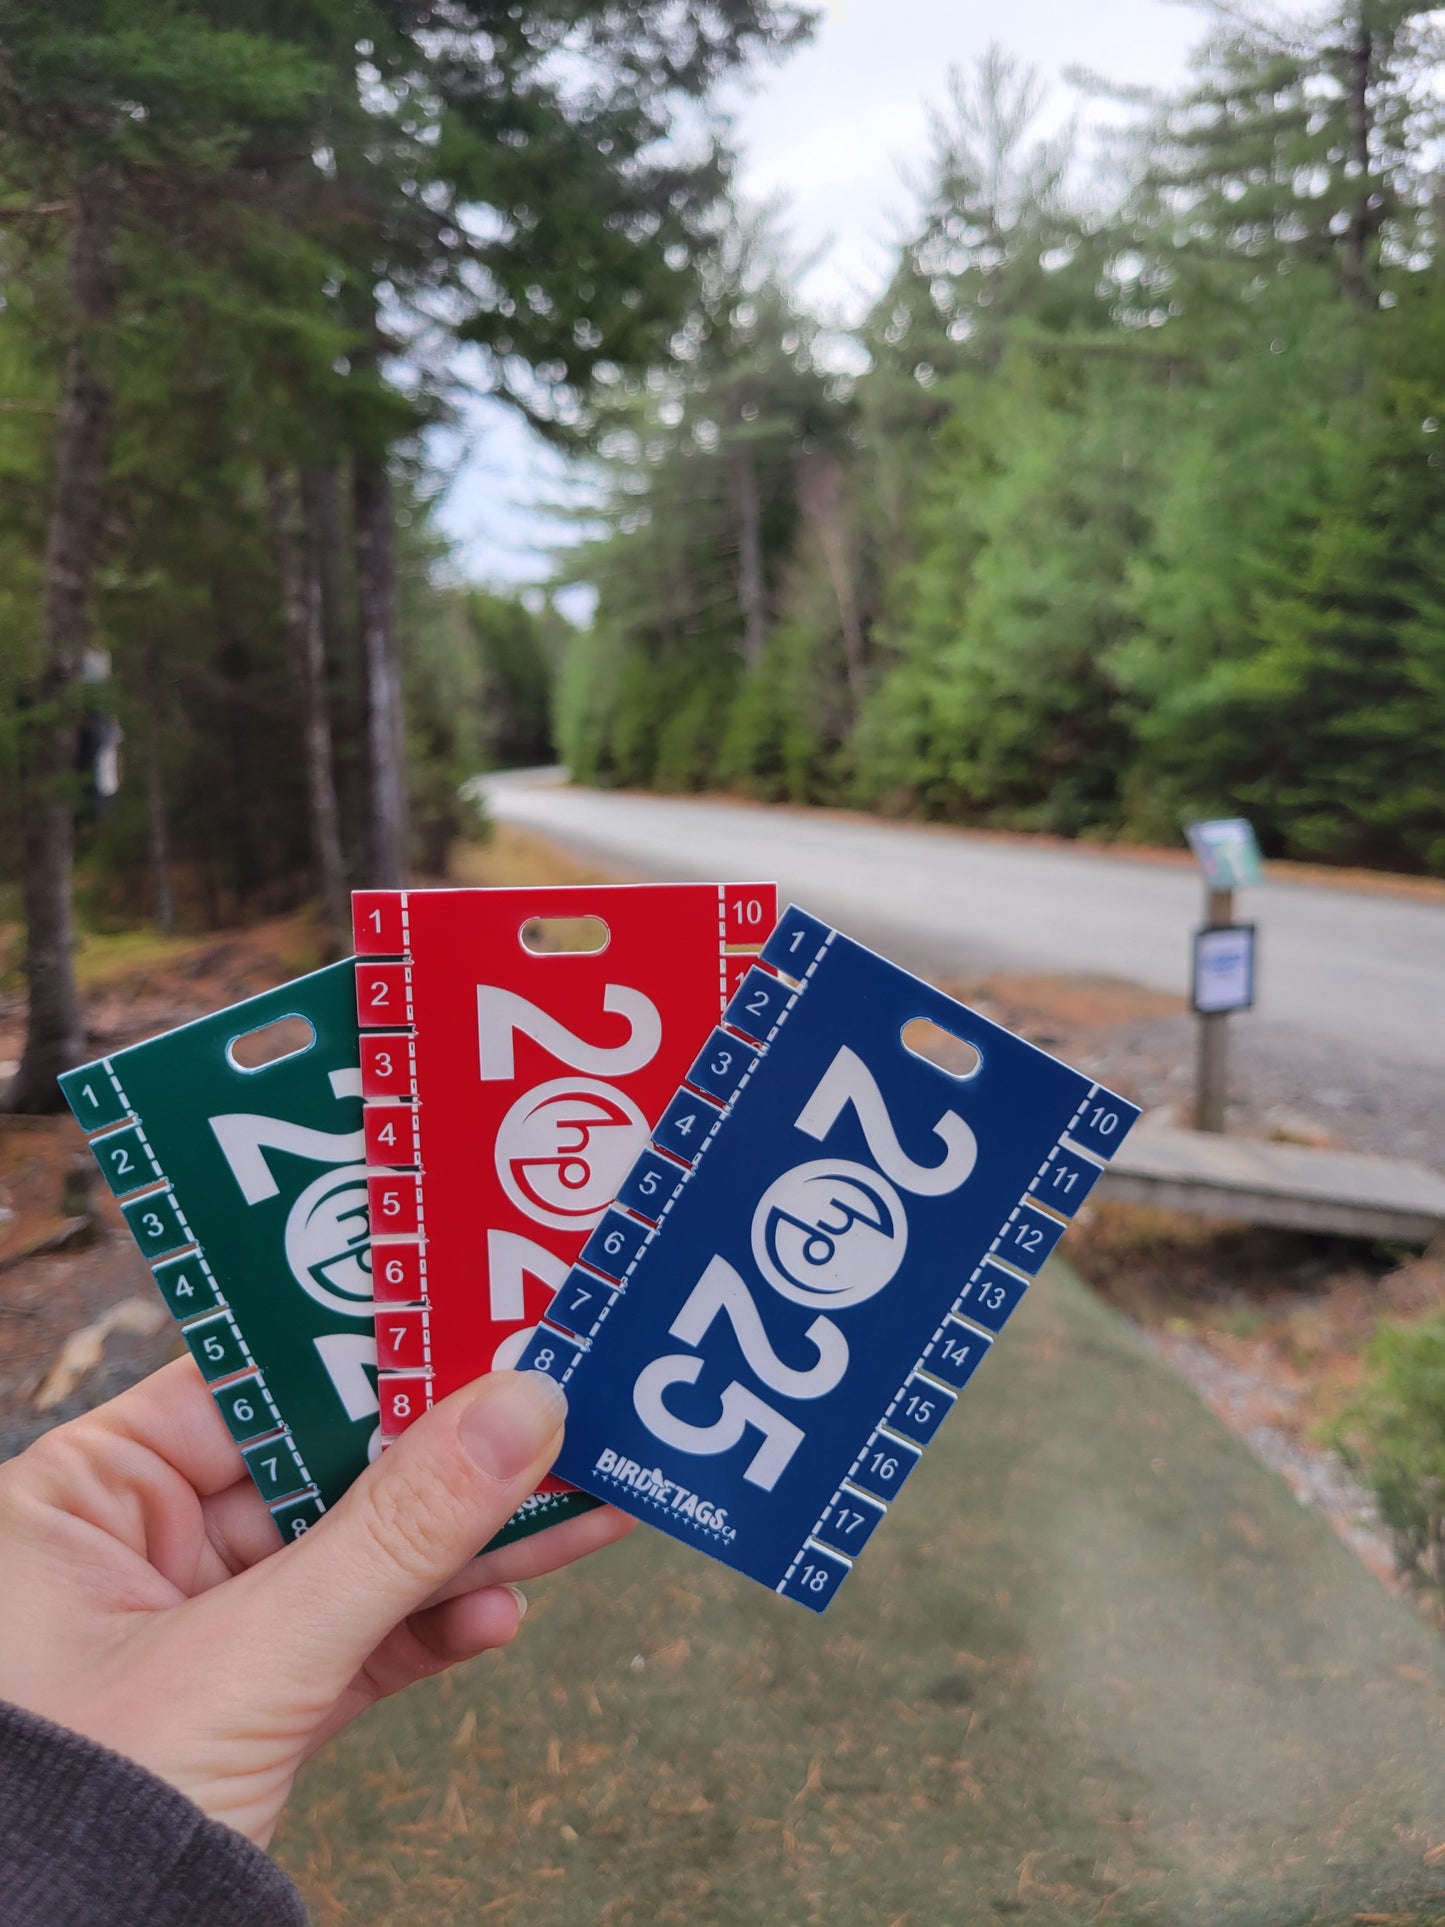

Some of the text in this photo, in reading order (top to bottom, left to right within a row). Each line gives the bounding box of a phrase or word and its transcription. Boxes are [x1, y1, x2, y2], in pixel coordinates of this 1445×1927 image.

[369, 909, 381, 934] 1
[732, 900, 763, 925] 10
[789, 931, 805, 953] 1
[371, 982, 390, 1006] 2
[745, 990, 770, 1017] 2
[375, 1053, 393, 1077] 3
[711, 1051, 733, 1076] 3
[82, 1084, 99, 1108] 1
[675, 1114, 696, 1136] 4
[1089, 1106, 1119, 1135] 10
[378, 1123, 397, 1147] 4
[111, 1149, 135, 1175] 2
[638, 1171, 662, 1195] 5
[1053, 1166, 1079, 1194] 11
[383, 1192, 401, 1216] 5
[142, 1213, 165, 1237] 3
[603, 1230, 625, 1255] 6
[1015, 1224, 1044, 1253] 12
[385, 1260, 404, 1284] 6
[175, 1274, 195, 1298] 4
[978, 1281, 1006, 1309] 13
[570, 1287, 593, 1311] 7
[203, 1337, 225, 1361] 5
[388, 1327, 407, 1351] 7
[534, 1348, 555, 1371] 8
[941, 1339, 970, 1367] 14
[233, 1398, 254, 1422] 6
[393, 1394, 411, 1417] 8
[906, 1395, 936, 1423] 15
[260, 1457, 280, 1482] 7
[870, 1452, 899, 1480] 16
[836, 1508, 865, 1534] 17
[800, 1564, 829, 1592] 18
